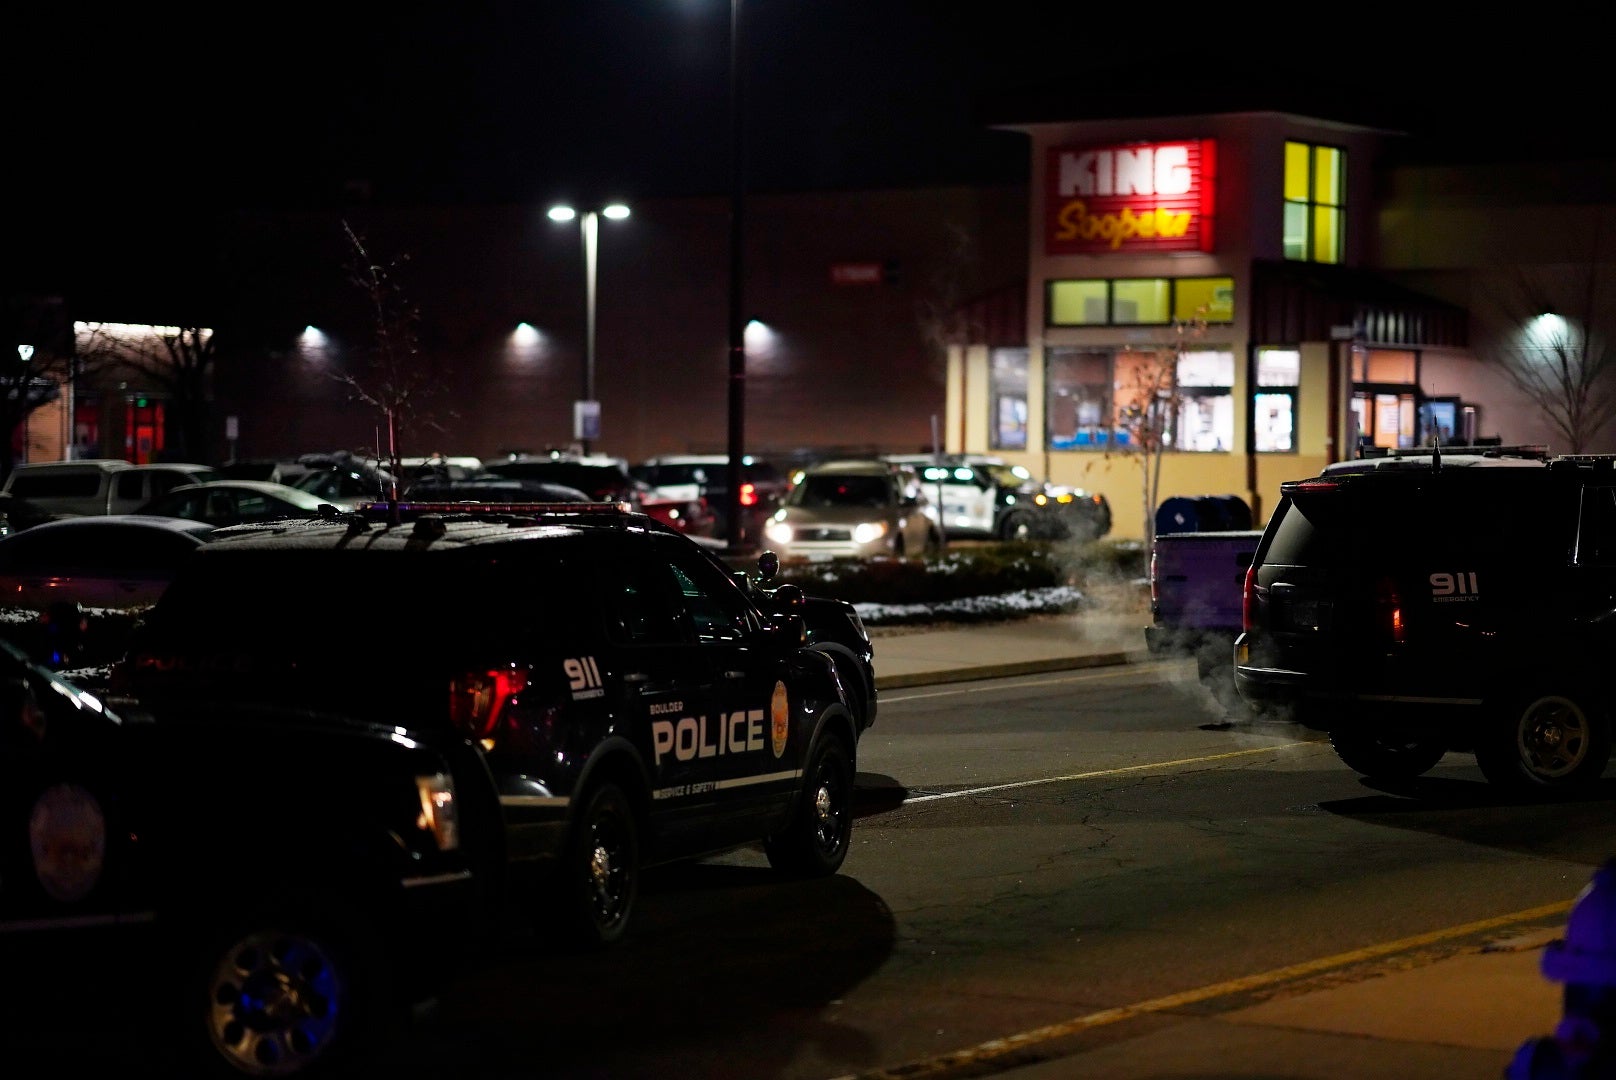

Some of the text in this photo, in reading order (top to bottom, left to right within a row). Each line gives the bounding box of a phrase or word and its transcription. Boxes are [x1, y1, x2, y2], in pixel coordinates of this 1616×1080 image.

[1059, 146, 1192, 196] KING
[1429, 571, 1479, 595] 911
[563, 655, 603, 690] 911
[649, 700, 684, 715] BOULDER
[652, 709, 765, 766] POLICE
